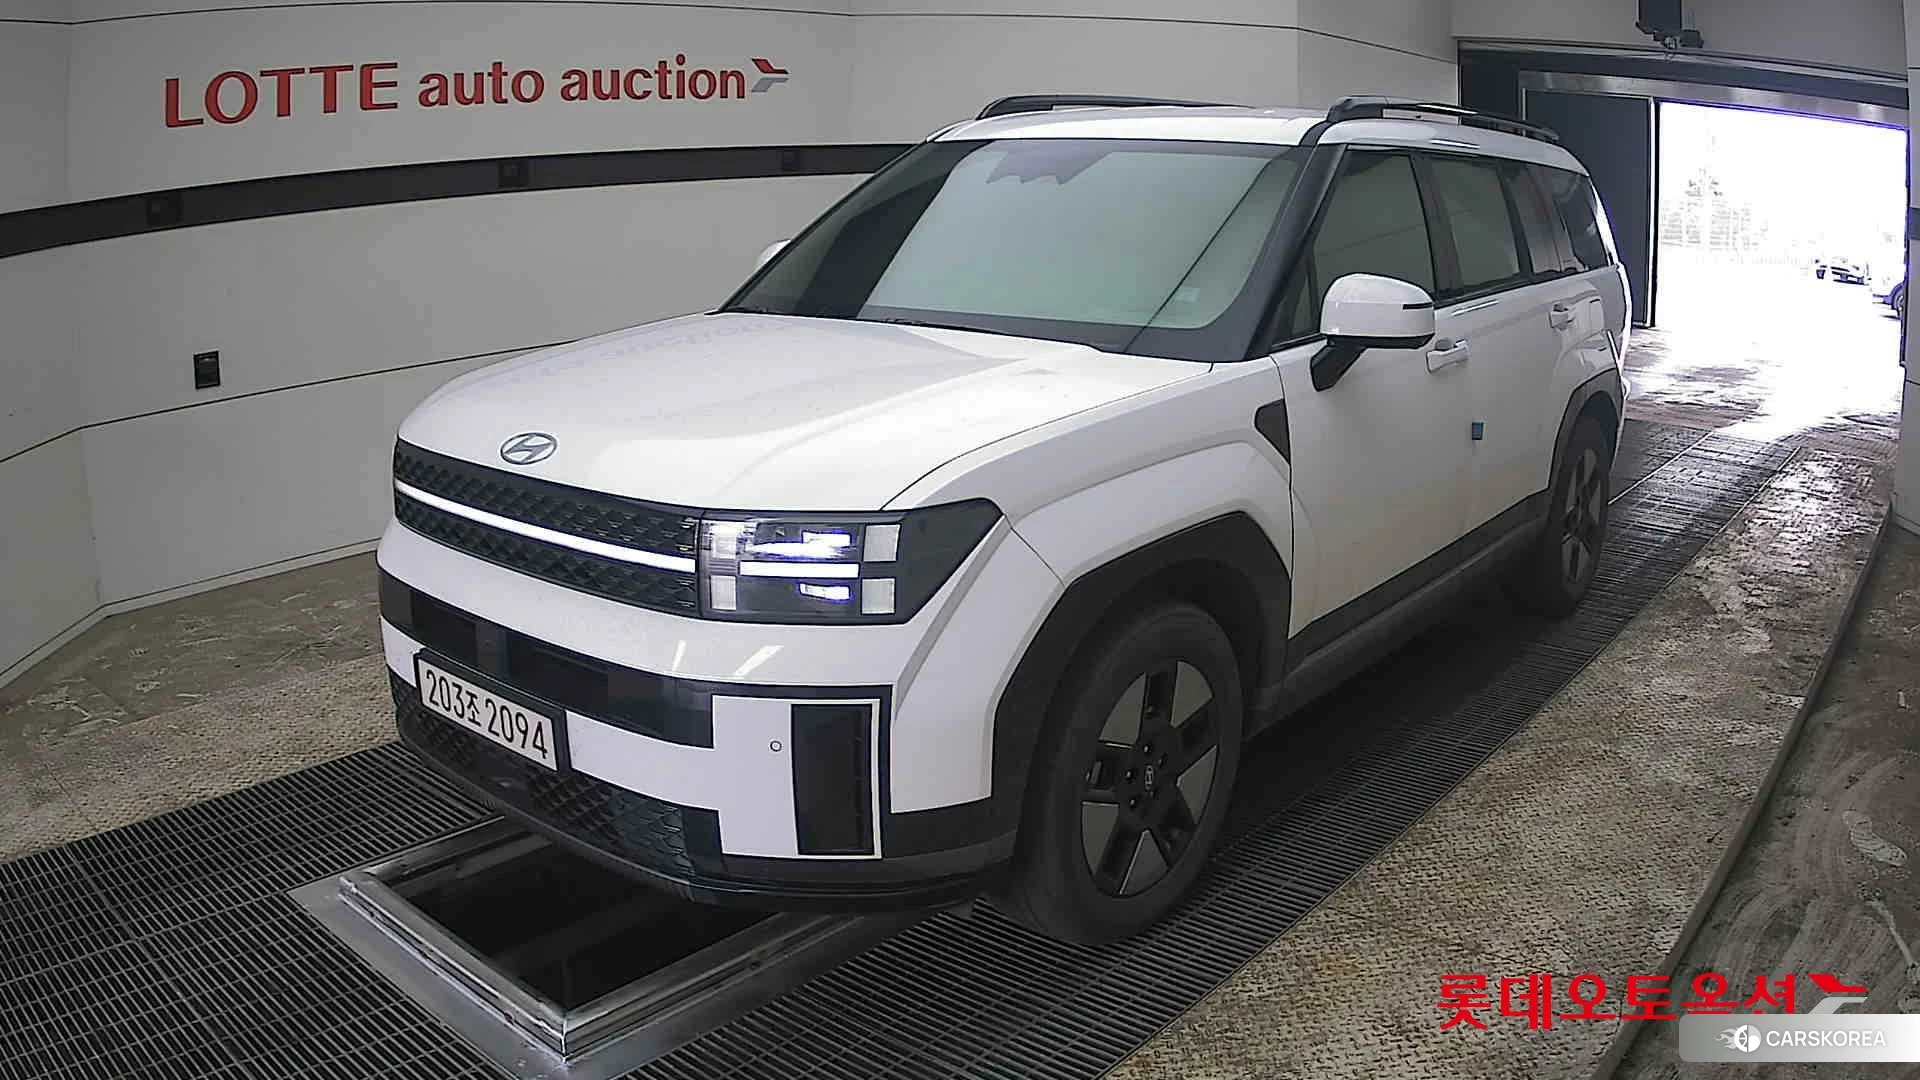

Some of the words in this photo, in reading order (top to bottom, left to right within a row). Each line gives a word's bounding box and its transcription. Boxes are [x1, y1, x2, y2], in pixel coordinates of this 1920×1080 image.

[165, 63, 398, 127] LOTTE
[418, 61, 545, 107] auto
[560, 54, 745, 101] auction
[485, 698, 548, 760] 2094
